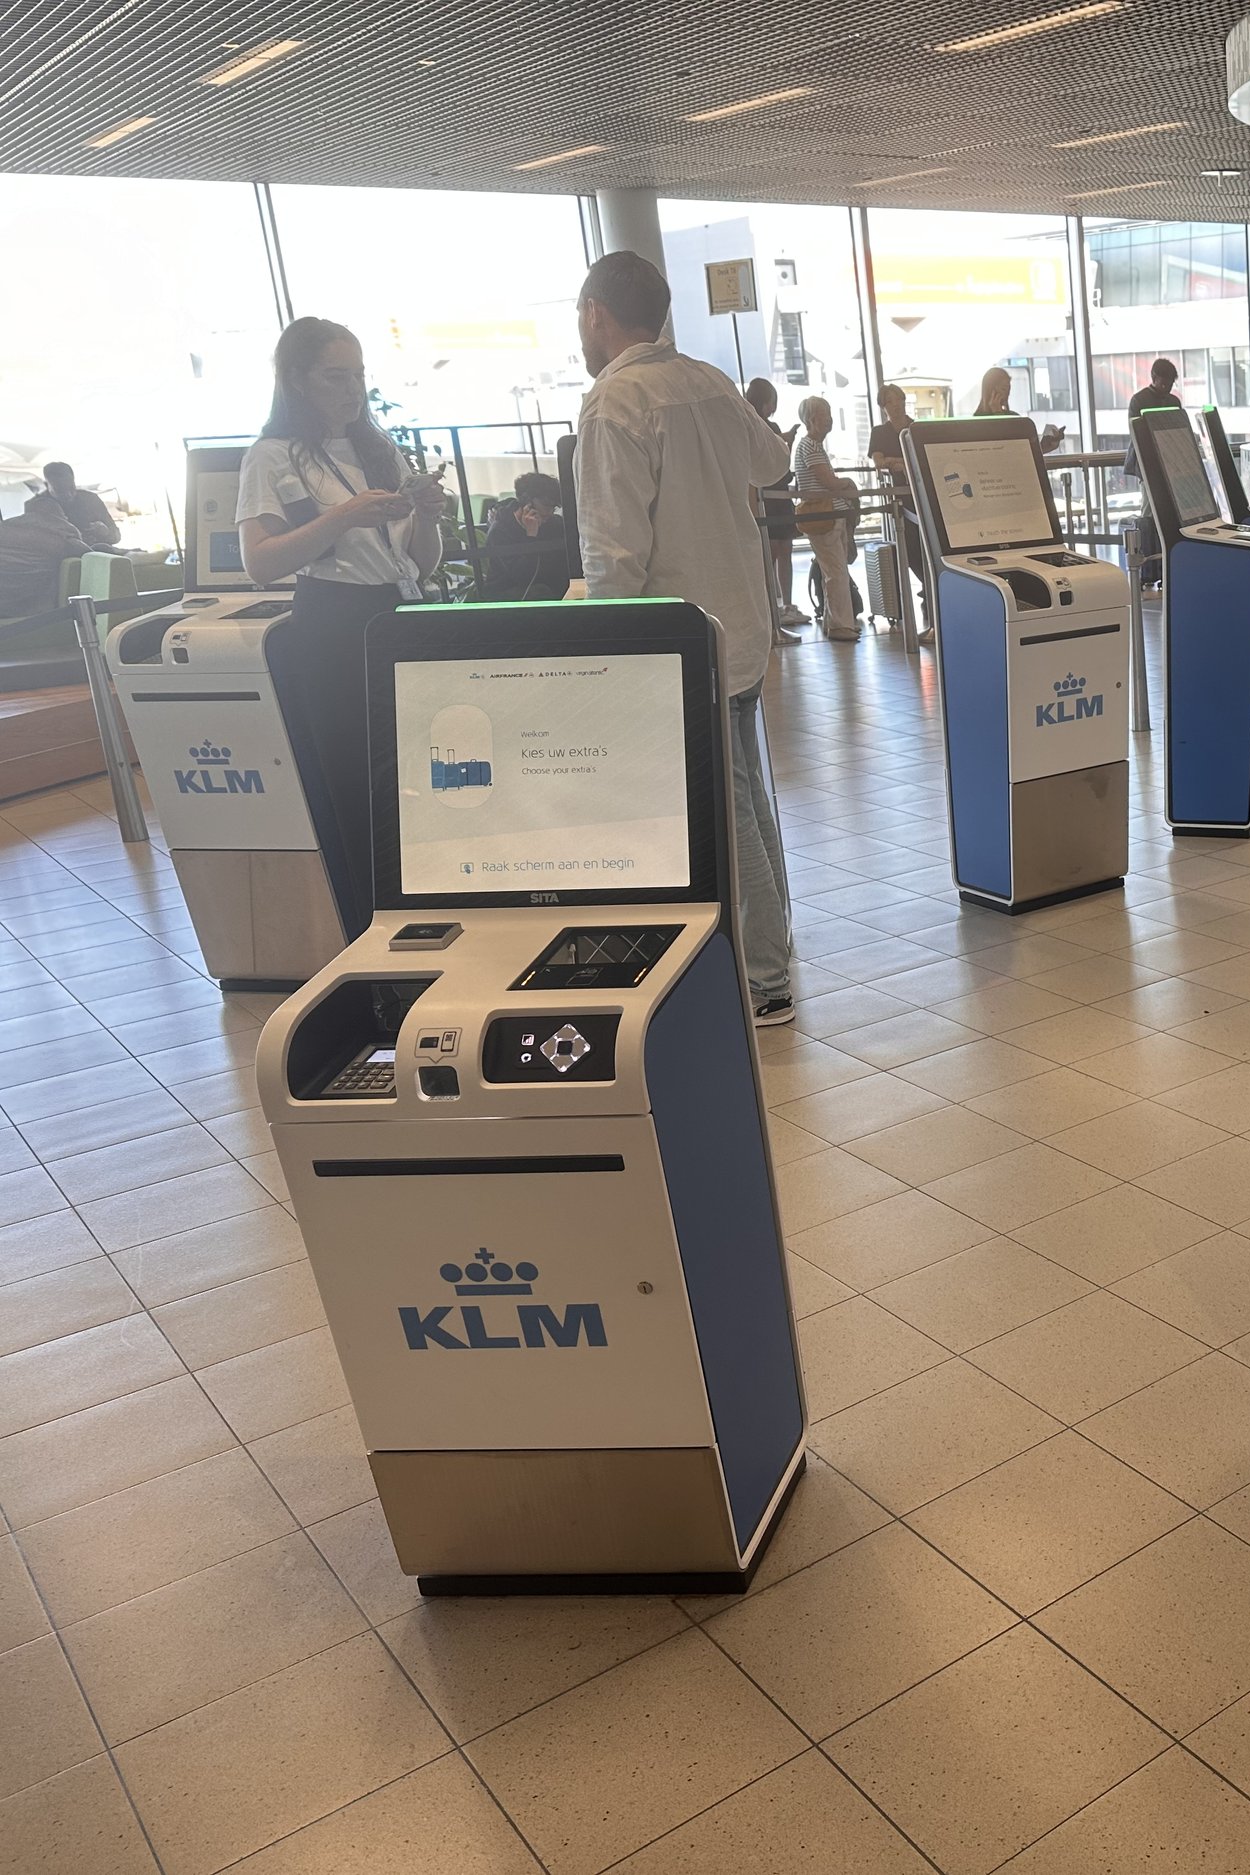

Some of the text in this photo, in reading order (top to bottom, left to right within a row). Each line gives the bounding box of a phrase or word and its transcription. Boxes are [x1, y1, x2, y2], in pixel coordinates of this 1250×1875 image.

[1035, 694, 1104, 728] KLM
[520, 730, 550, 738] Welkom
[521, 745, 608, 758] Kies uw extra's
[521, 765, 597, 775] Choose your extra's
[174, 769, 266, 794] KLM
[481, 857, 635, 873] Raak scherm aan en begin
[530, 892, 560, 904] SITA
[397, 1302, 609, 1351] KLM
